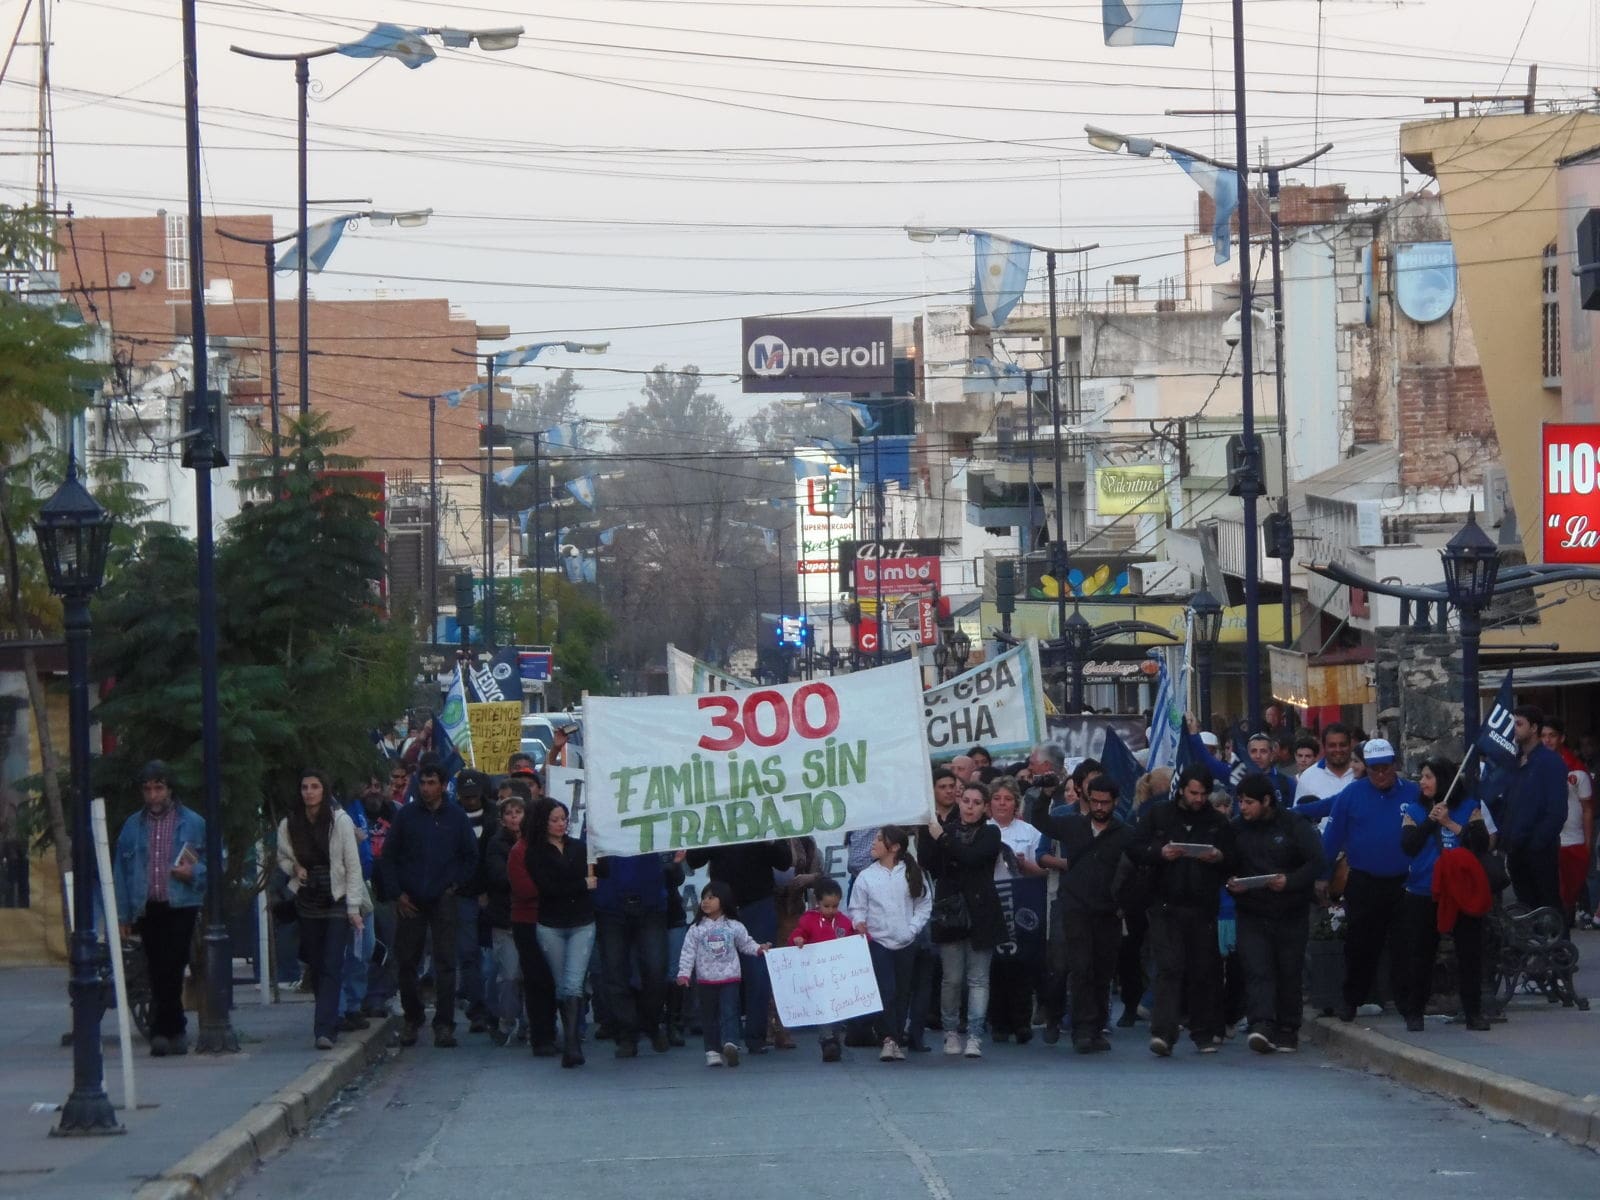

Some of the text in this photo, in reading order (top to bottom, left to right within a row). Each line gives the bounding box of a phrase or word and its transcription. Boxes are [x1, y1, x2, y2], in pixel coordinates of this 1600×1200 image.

[791, 341, 885, 367] meroli
[1549, 443, 1600, 494] HO
[802, 523, 854, 531] UPERMRCADO
[697, 682, 840, 751] 300
[802, 737, 868, 788] SIN
[620, 789, 847, 852] TRABAJO
